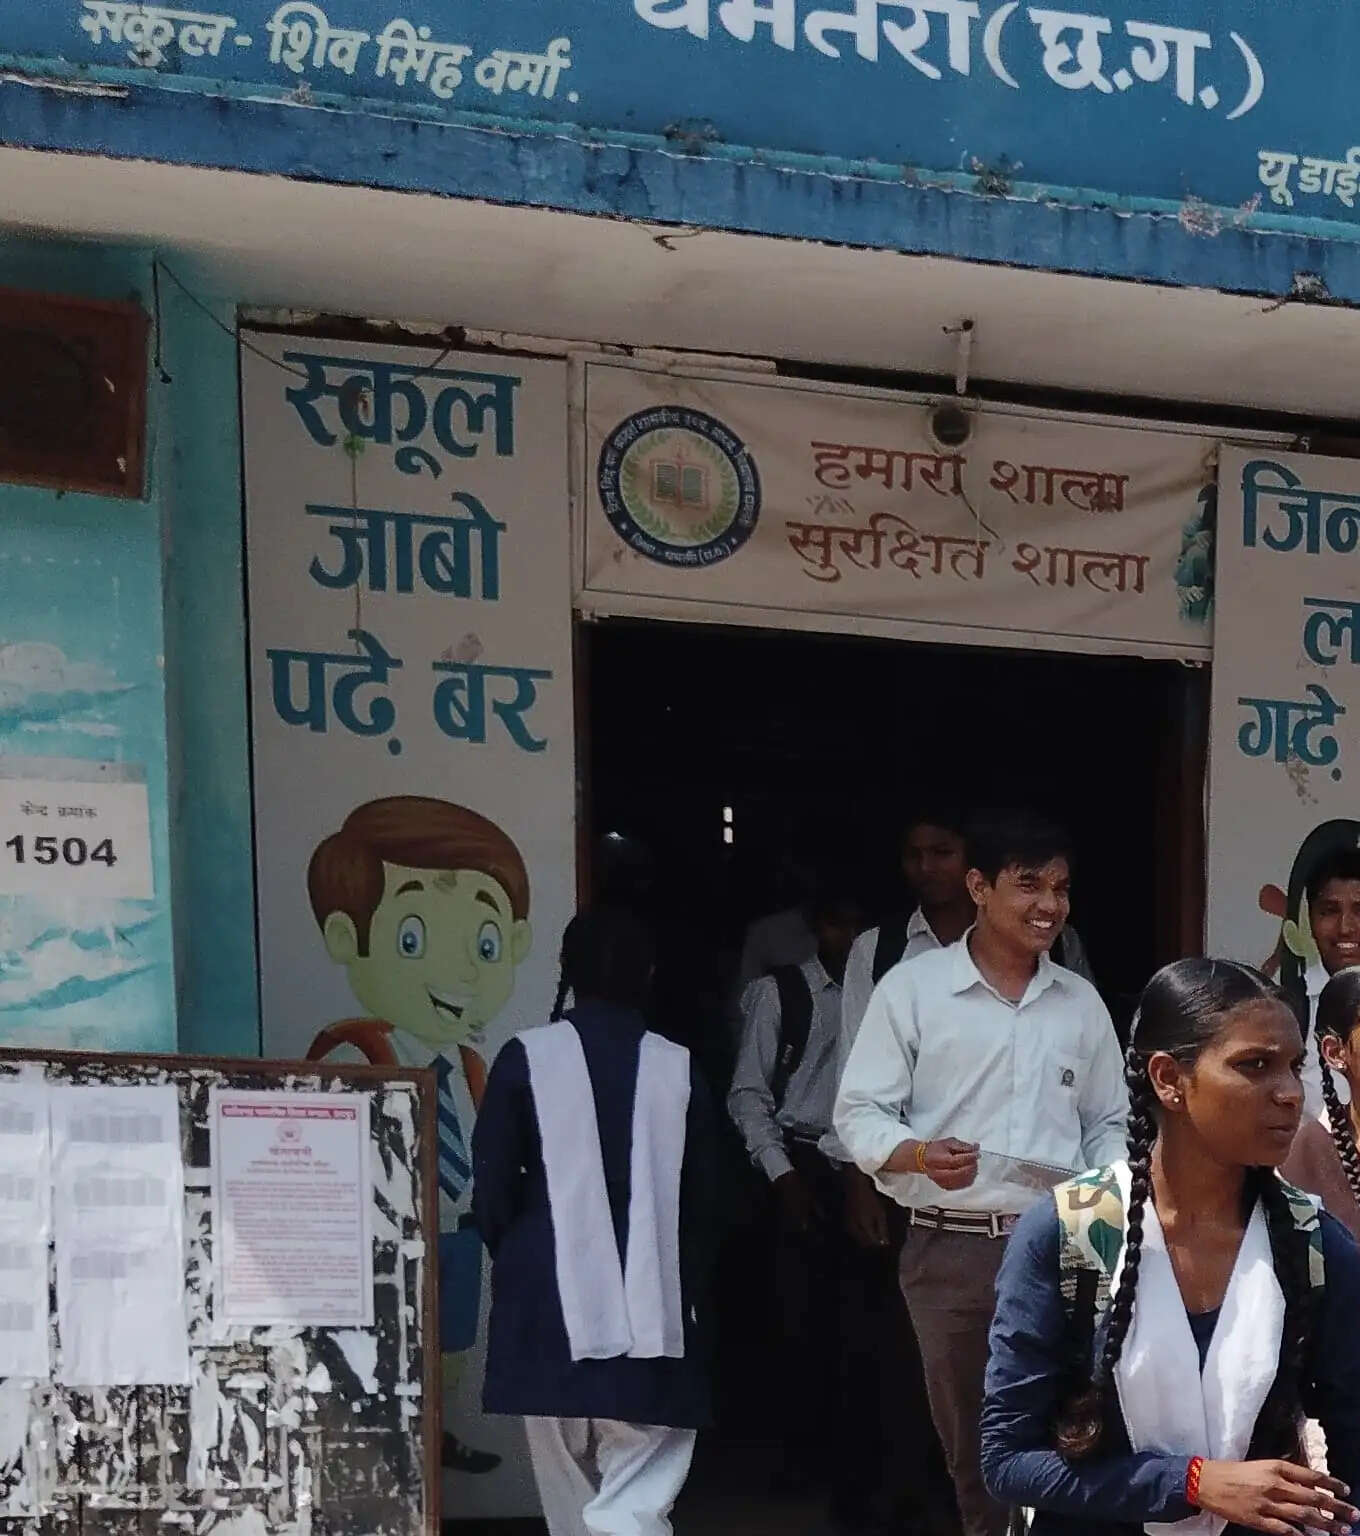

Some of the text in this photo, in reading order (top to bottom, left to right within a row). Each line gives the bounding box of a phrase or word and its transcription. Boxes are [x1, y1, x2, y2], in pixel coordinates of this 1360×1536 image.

[266, 2, 370, 75] शिव
[375, 18, 472, 98] सिंह
[1258, 150, 1299, 206] यू
[284, 350, 522, 479] स्कूल
[305, 492, 507, 600] जाबो
[786, 512, 1150, 593] सुरक्षित शाला
[432, 659, 553, 753] बर
[6, 834, 118, 868] 1504
